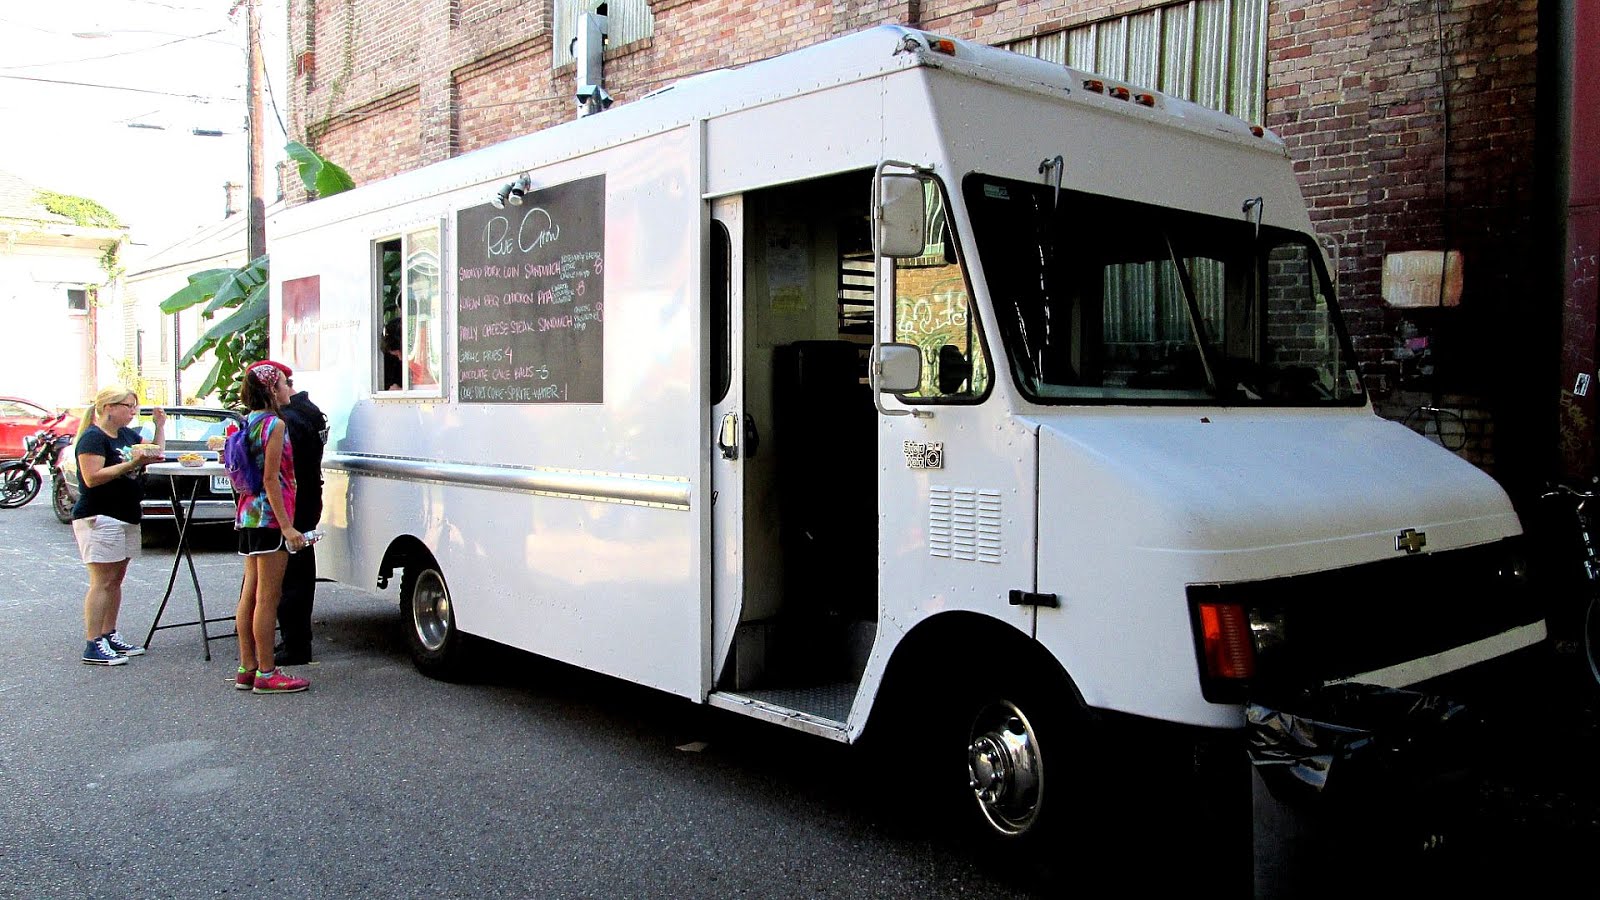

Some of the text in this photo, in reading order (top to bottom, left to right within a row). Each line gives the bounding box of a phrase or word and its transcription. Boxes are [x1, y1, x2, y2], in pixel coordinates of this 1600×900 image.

[504, 264, 520, 279] LOIN
[525, 260, 560, 279] SANDWICH
[503, 291, 534, 305] CHICKEN
[537, 288, 554, 305] PITA
[537, 314, 573, 332] SANDWICH
